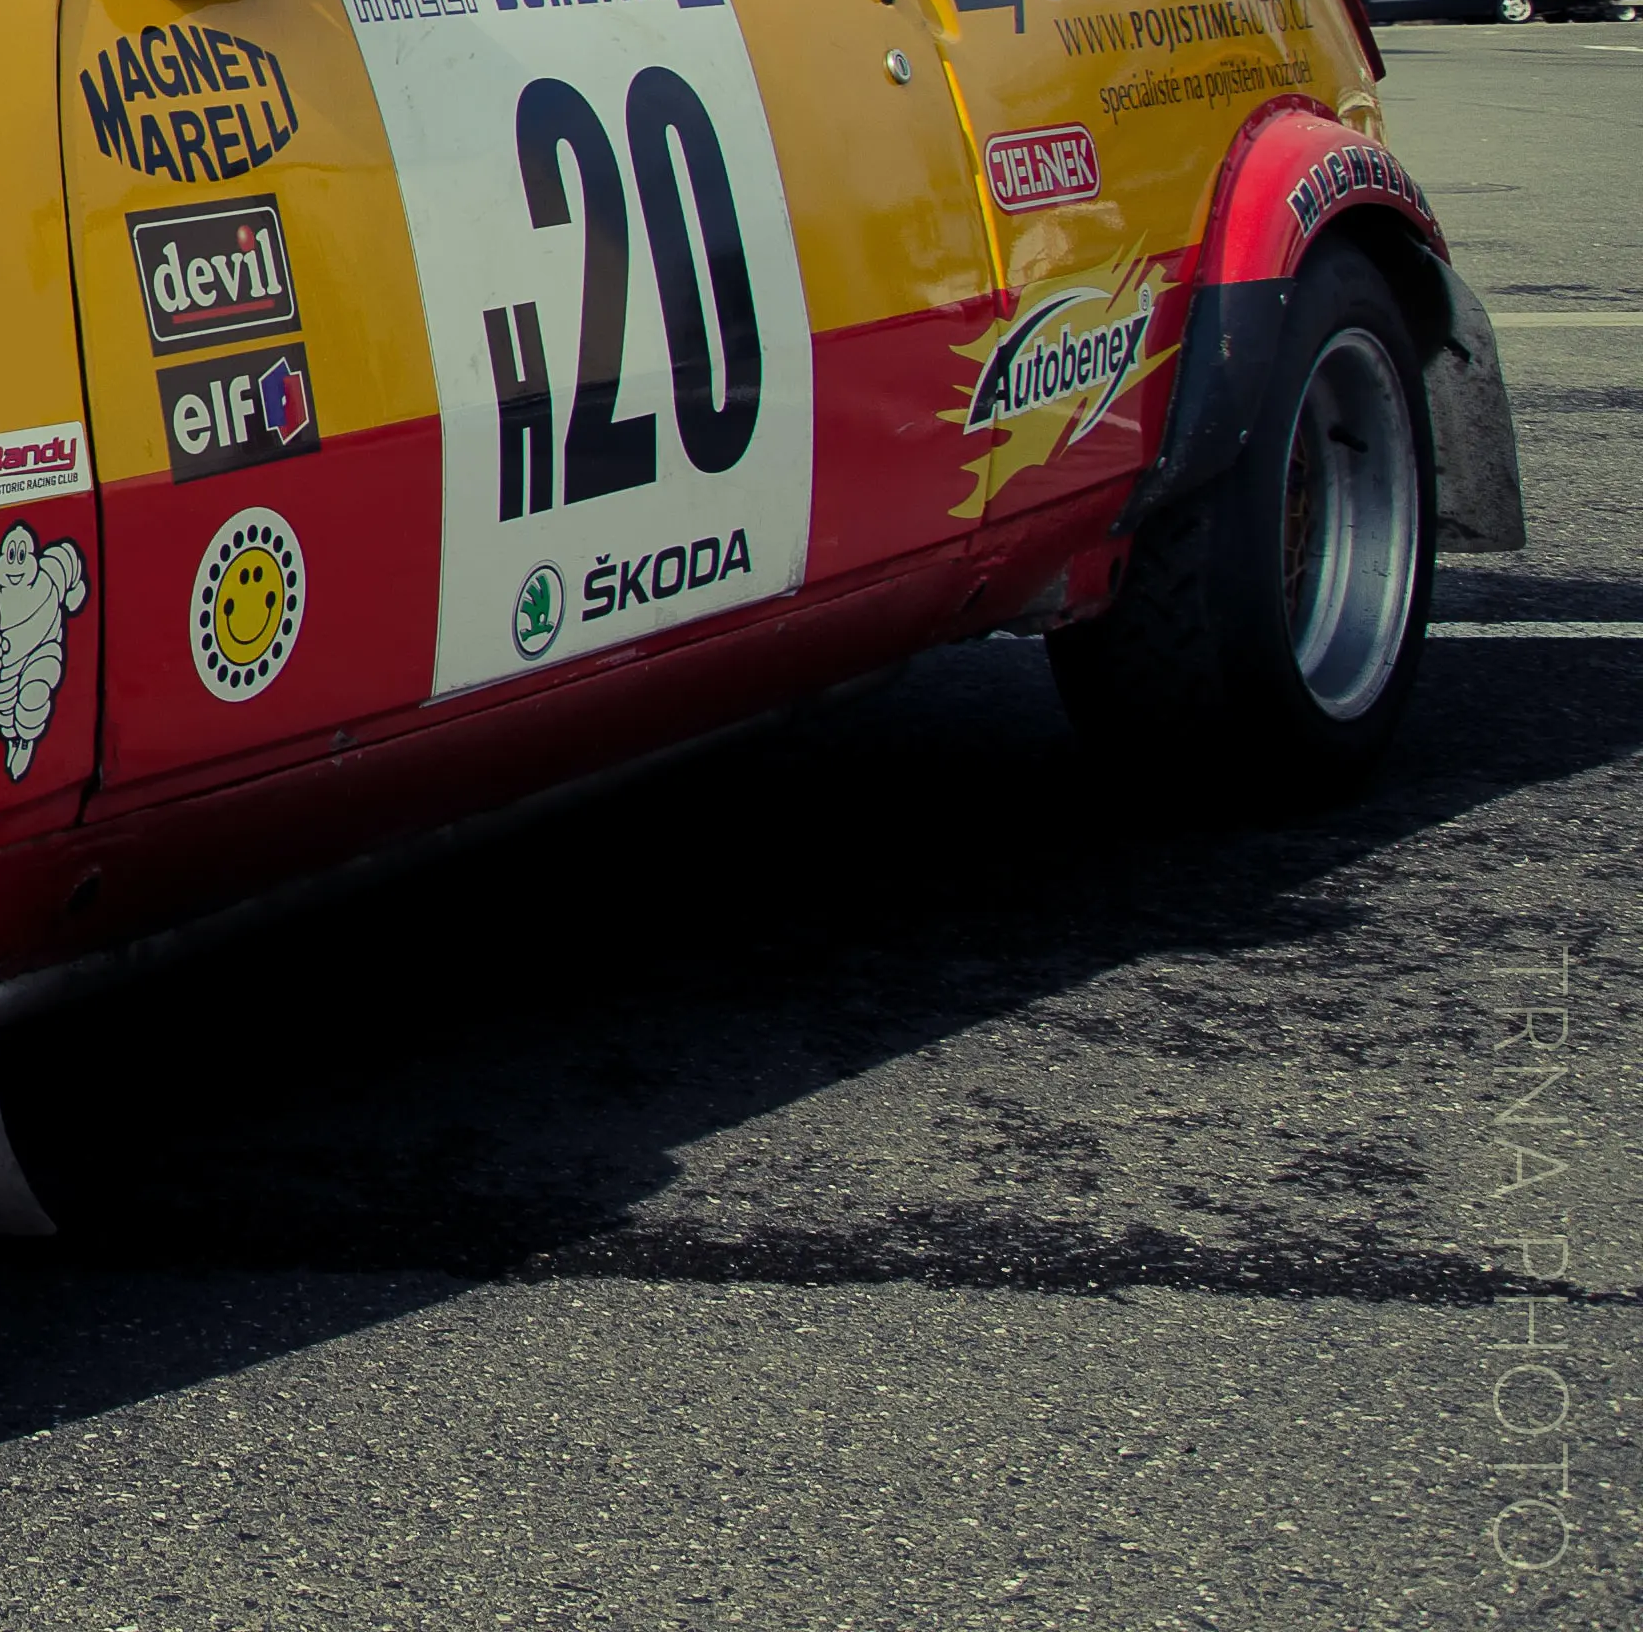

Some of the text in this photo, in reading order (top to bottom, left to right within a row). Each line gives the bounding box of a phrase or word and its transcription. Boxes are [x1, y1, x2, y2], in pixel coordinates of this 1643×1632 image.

[80, 25, 299, 138] MAGNETI
[1184, 75, 1204, 101] na
[90, 98, 299, 184] MARELLI
[991, 137, 1096, 199] JELINEK
[1286, 145, 1433, 240] MICHELIN
[152, 224, 283, 314] devil
[967, 298, 1150, 428] Autobenex
[173, 372, 255, 454] elf
[26, 475, 56, 491] RACING
[57, 472, 79, 485] CLUB
[581, 527, 753, 623] ŠKODA
